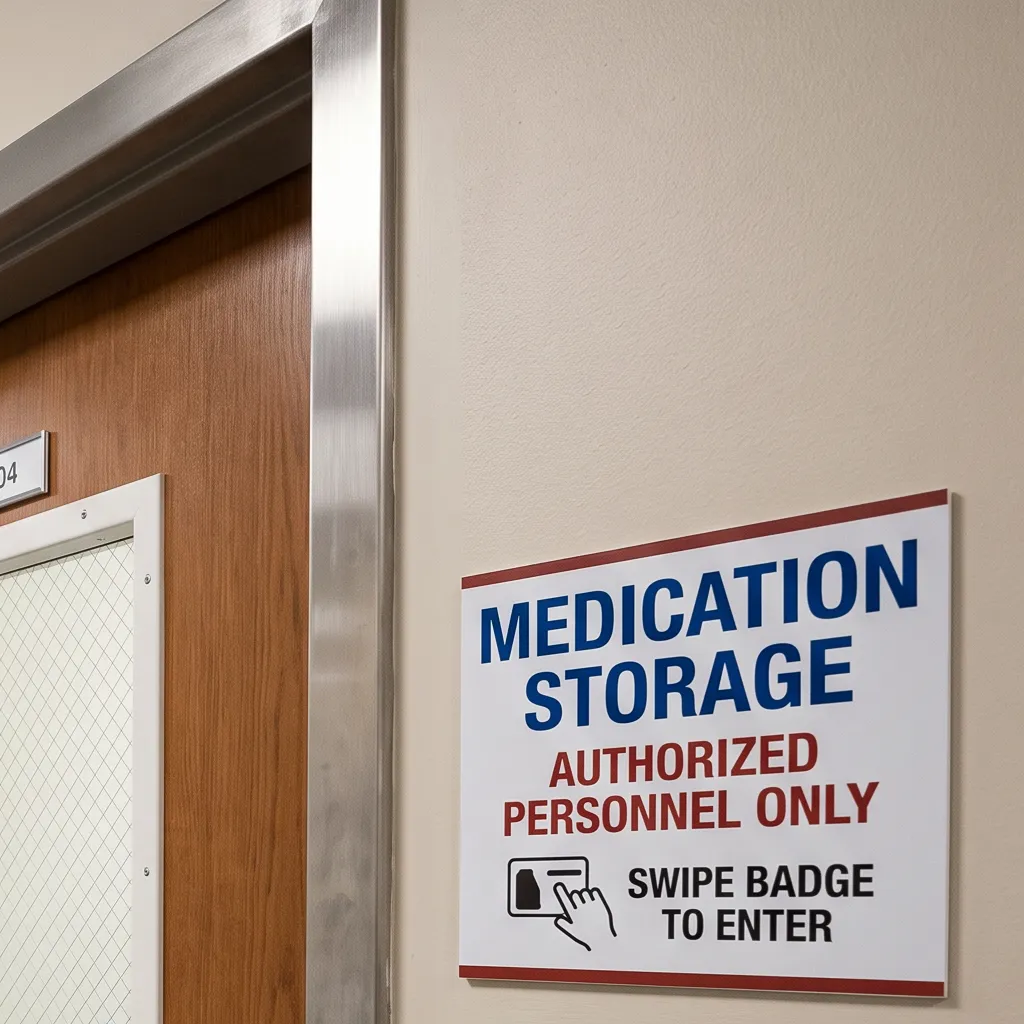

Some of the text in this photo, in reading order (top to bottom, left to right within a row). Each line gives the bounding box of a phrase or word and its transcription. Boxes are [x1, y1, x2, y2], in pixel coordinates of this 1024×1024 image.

[480, 538, 918, 664] MEDICATION
[524, 635, 854, 732] STORAGE
[549, 732, 819, 787] AUTHORIZED
[503, 781, 880, 837] PERSONNEL ONLY
[627, 863, 874, 899] SWIPE BADGE
[661, 908, 833, 943] TO ENTER
